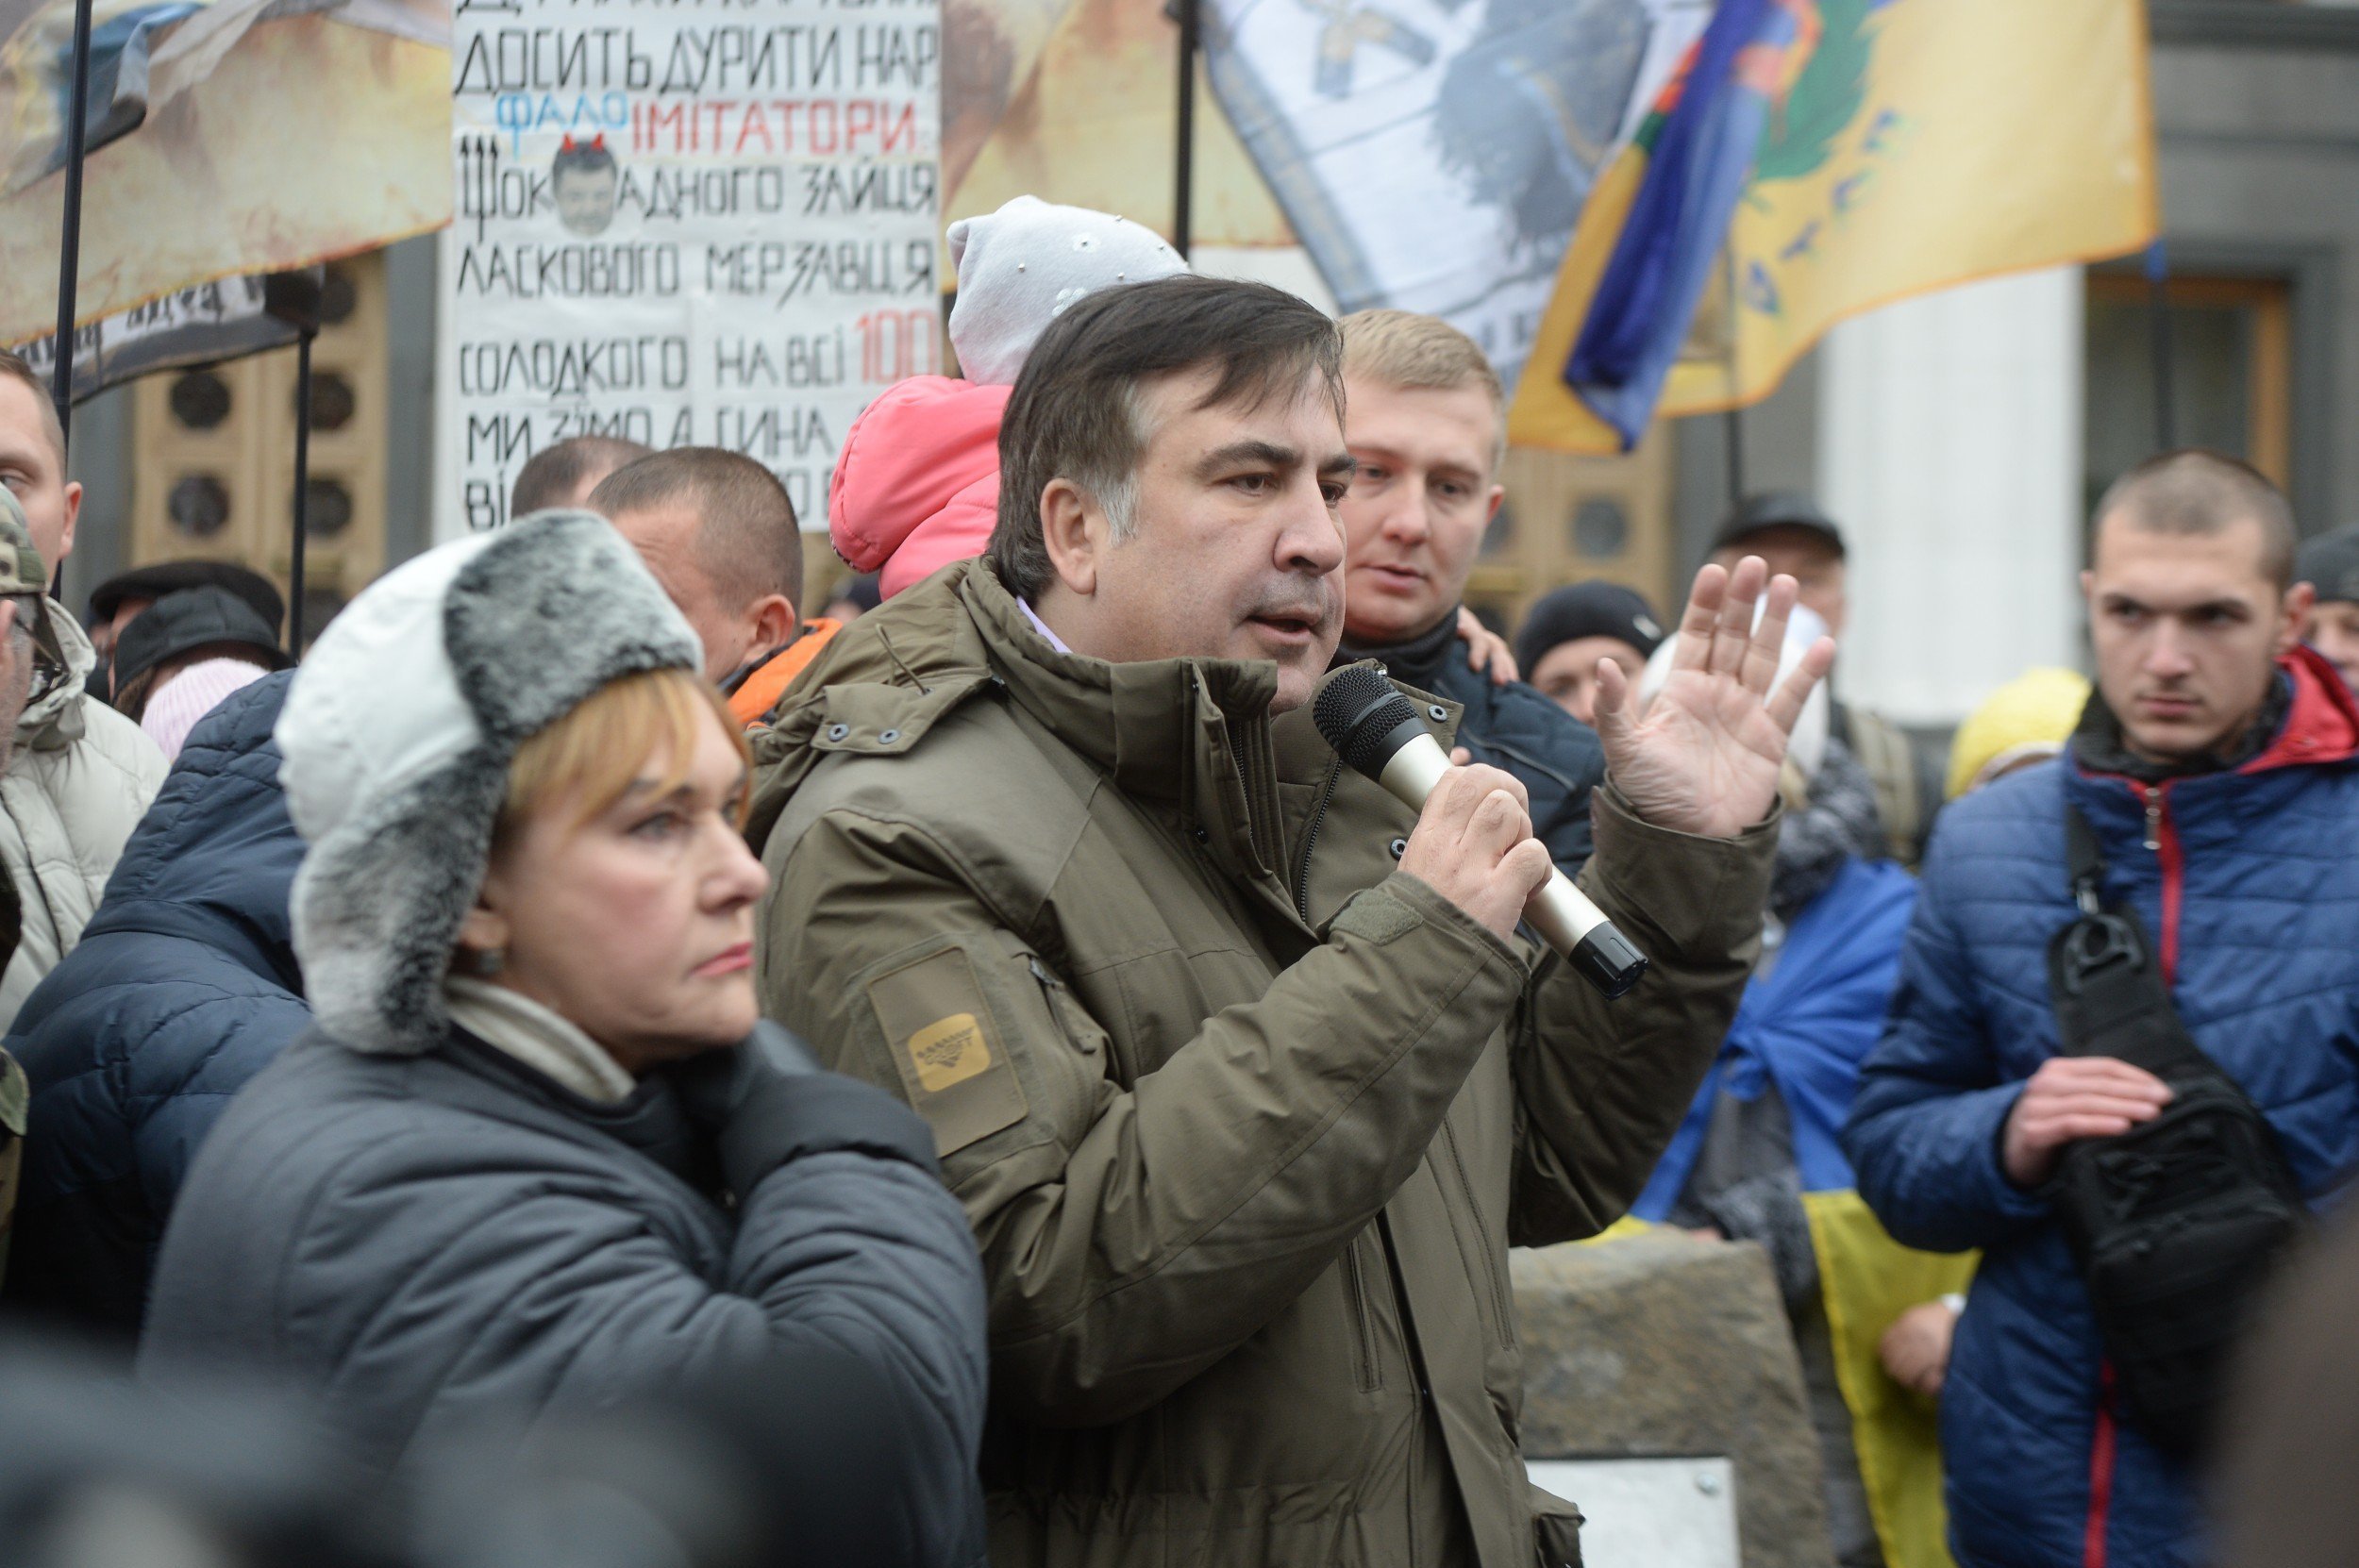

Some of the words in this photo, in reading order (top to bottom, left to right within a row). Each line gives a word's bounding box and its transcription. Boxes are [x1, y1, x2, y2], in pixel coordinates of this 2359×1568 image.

[453, 26, 653, 97] ДОСИТЬ
[658, 24, 843, 96] ДУРИТИ
[457, 242, 680, 298] ЛАСКОВОГО
[705, 239, 935, 309] МЕРЗАВЦЯ
[460, 335, 688, 402] СОЛОДКОГО
[468, 412, 532, 464] МИ
